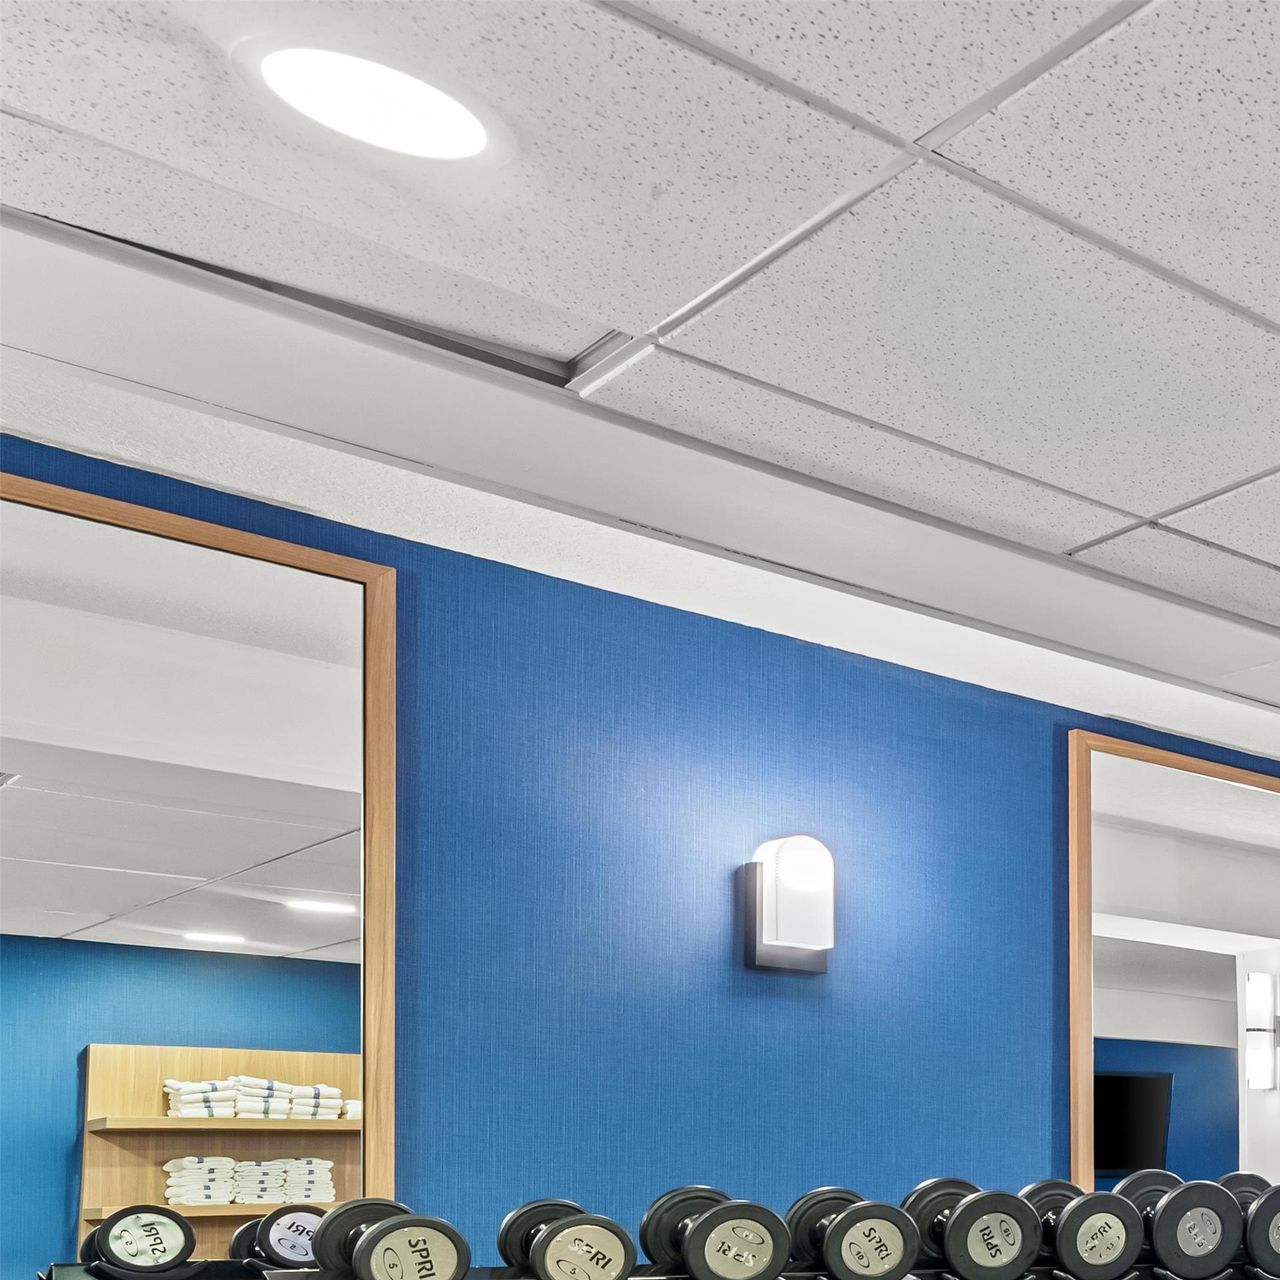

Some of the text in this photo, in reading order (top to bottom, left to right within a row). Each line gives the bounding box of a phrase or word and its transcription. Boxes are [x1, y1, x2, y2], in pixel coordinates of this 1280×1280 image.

[408, 1237, 436, 1279] SPRI
[567, 1238, 613, 1270] SPRI
[716, 1241, 757, 1267] SPRI
[856, 1251, 862, 1260] 10
[863, 1227, 892, 1260] SPRI
[980, 1226, 1002, 1258] SPRI
